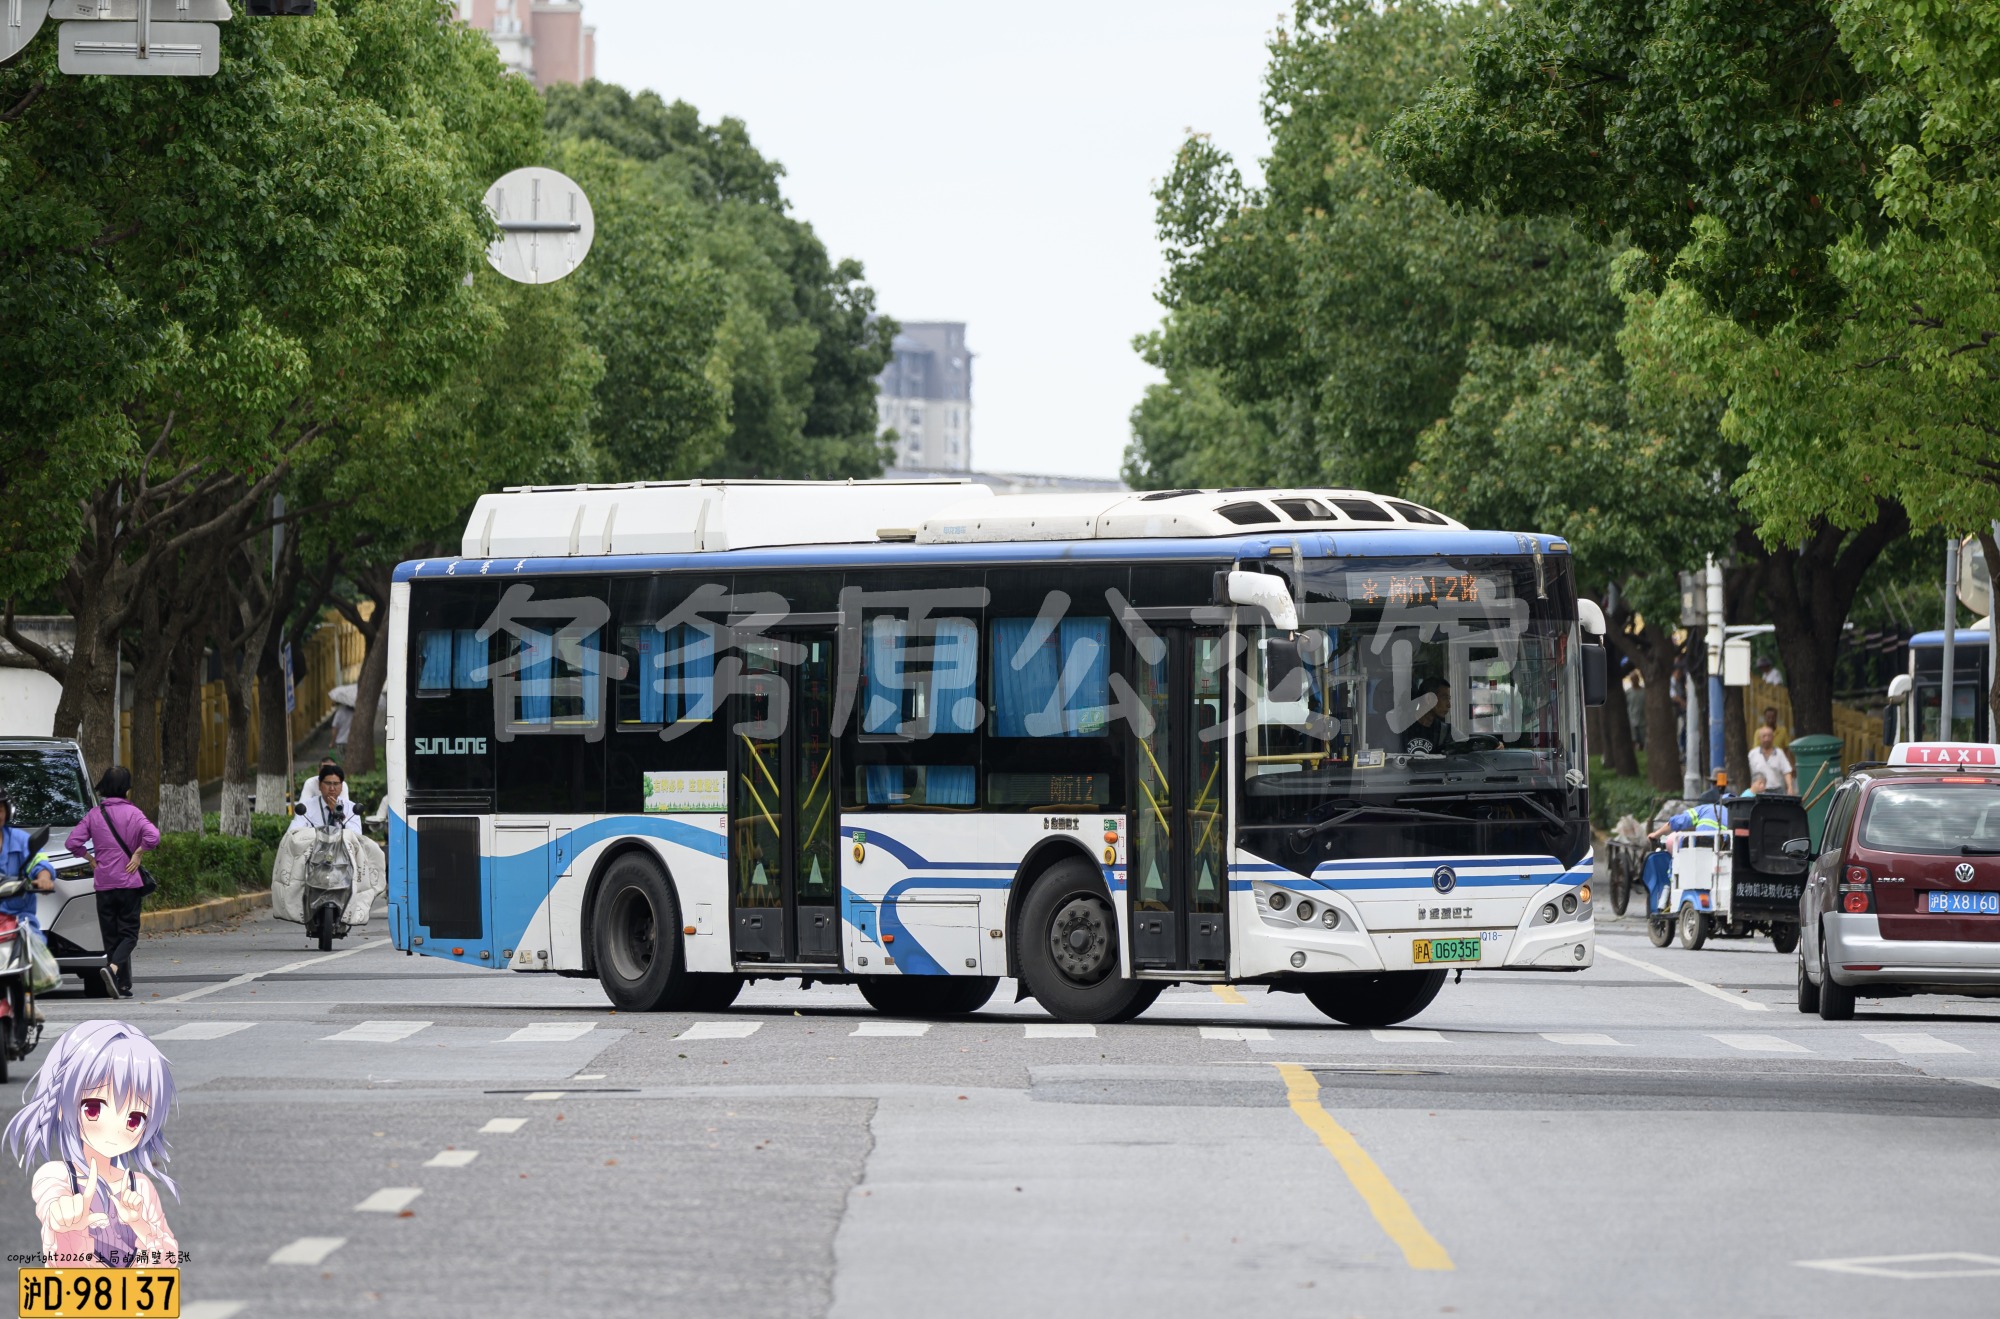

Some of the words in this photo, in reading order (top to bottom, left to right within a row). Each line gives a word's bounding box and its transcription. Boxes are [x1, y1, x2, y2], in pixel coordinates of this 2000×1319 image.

[1390, 575, 1479, 603] 闵行12路
[414, 737, 487, 755] SUNLONG
[1920, 749, 1982, 764] TAXI
